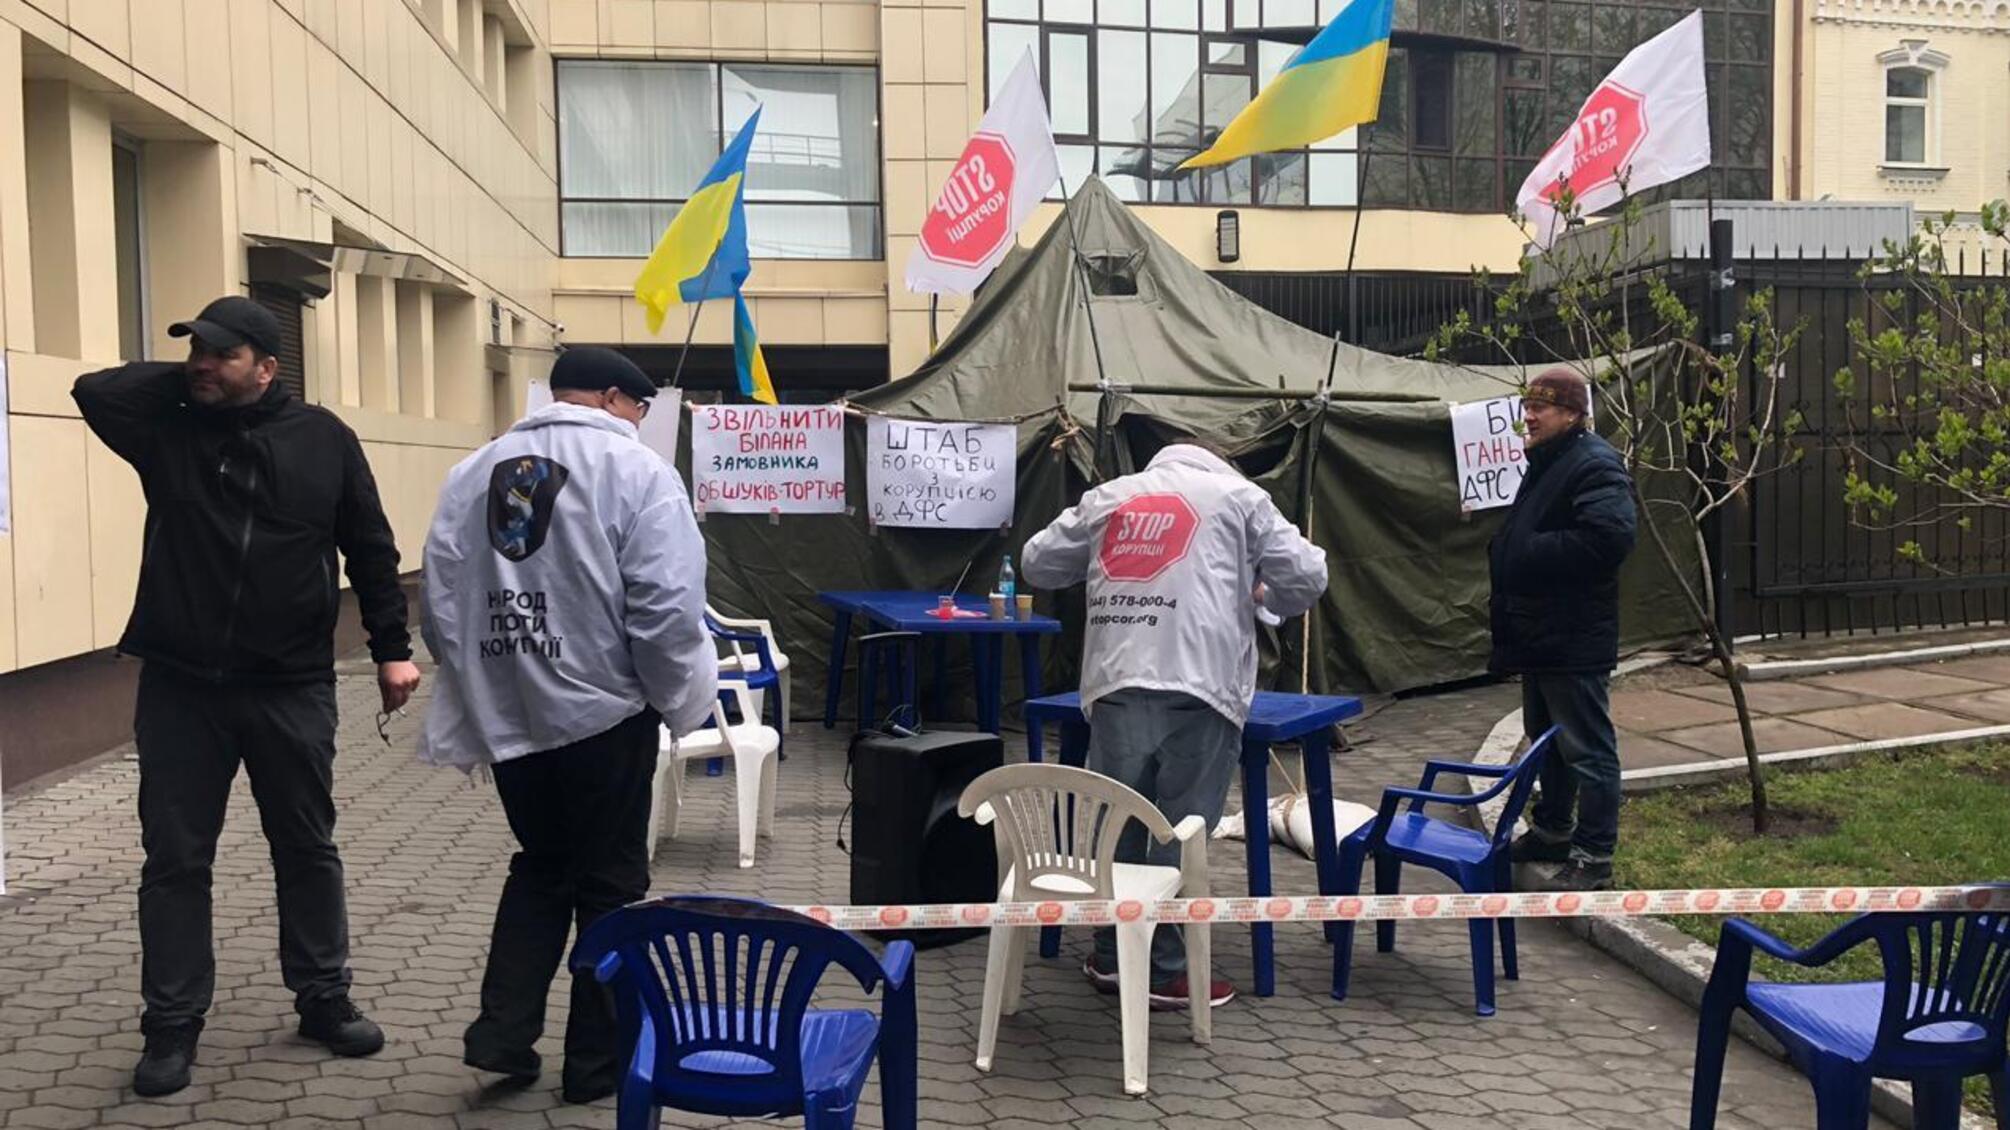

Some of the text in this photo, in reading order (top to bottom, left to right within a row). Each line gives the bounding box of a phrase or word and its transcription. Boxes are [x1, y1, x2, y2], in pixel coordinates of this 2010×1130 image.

[707, 407, 841, 431] ЗВІЛЬНИТИ
[887, 424, 985, 454] ШТАБ
[712, 455, 819, 471] ЗАМОВНИКА
[882, 454, 996, 471] БОРОТЬБИ
[1464, 436, 1522, 469] ГАНЬ
[883, 483, 997, 502] КОРУПЦІЄЮ
[1461, 467, 1510, 504] ДФС
[893, 499, 948, 522] ДФС
[1117, 511, 1177, 542] STOP
[1109, 594, 1177, 610] 578-000-4
